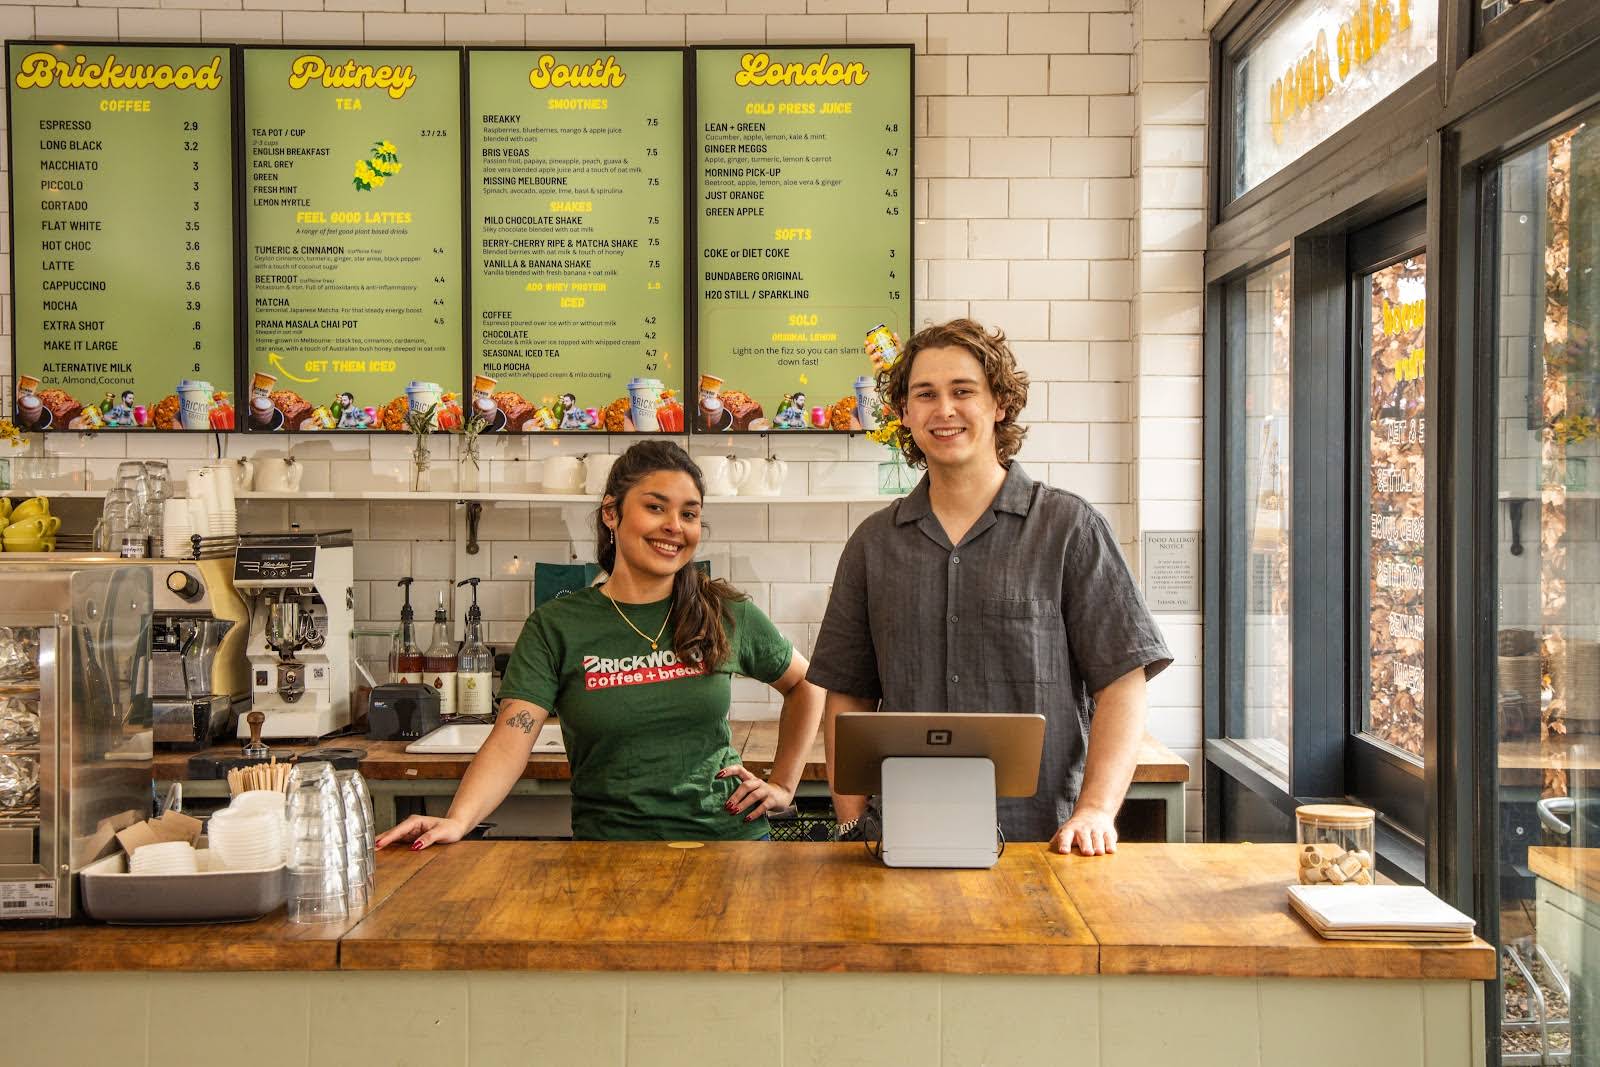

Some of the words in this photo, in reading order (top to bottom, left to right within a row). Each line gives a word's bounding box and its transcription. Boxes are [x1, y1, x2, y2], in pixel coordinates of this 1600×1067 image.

[16, 52, 223, 90] Brickwood
[528, 54, 626, 90] South
[735, 53, 870, 87] London
[287, 54, 417, 101] Putney
[100, 99, 150, 113] COFFEE
[336, 98, 361, 110] TEA
[745, 103, 774, 114] COLD
[779, 103, 815, 113] PRESS
[821, 103, 852, 113] JUICE
[483, 115, 520, 123] BREAKKY
[40, 120, 91, 130] ESPRESSO
[184, 121, 198, 131] 2.9
[705, 123, 727, 131] LEAN
[737, 123, 765, 131] GREEN
[886, 124, 898, 132] 4.8
[40, 140, 66, 150] LONG
[70, 141, 102, 150] BLACK
[184, 141, 198, 151] 3.2
[705, 145, 736, 153] GINGER
[739, 145, 767, 153] MEGGS
[503, 149, 529, 157] VEGAS
[646, 148, 657, 156] 7.5
[886, 148, 898, 156] 4.7
[41, 160, 98, 170] MACCHIATO
[253, 160, 272, 168] EARL
[705, 169, 743, 177] MORNING
[746, 168, 780, 176] PICK-UP
[886, 168, 898, 176] 4.7
[253, 173, 278, 181] GREEN
[484, 177, 516, 185] MISSING
[518, 177, 567, 185] MELBOURNE
[41, 180, 83, 190] PICCOLO
[648, 178, 659, 186] 7.5
[705, 191, 727, 199] JUST
[730, 191, 764, 199] ORANGE
[885, 189, 897, 197] 4.5
[41, 200, 88, 211] CORTADO
[706, 208, 734, 216] GREEN
[737, 208, 764, 216] APPLE
[295, 211, 325, 224] FEEL
[330, 212, 362, 223] GOOD
[364, 212, 411, 224] LATTES
[42, 221, 67, 230] FLAT
[70, 221, 101, 230] WHITE
[186, 222, 199, 231] 3.5
[775, 228, 812, 241] SOFTS
[41, 241, 62, 251] HOT
[65, 241, 91, 251] CHOC
[186, 242, 199, 251] 3.6
[649, 238, 659, 246] 7.5
[255, 246, 290, 254] TUMERIC
[293, 246, 298, 254] &
[301, 246, 344, 254] CINNAMON
[704, 249, 728, 258] COKE
[743, 249, 763, 257] DIET
[766, 248, 789, 257] COKE
[43, 261, 74, 270] LATTE
[186, 262, 200, 270] 3.6
[484, 260, 518, 268] VANILLA
[521, 260, 526, 268] &
[529, 260, 562, 268] BANANA
[565, 260, 591, 268] SHAKE
[649, 260, 660, 268] 7.5
[255, 275, 297, 283] BEETROOT
[705, 272, 759, 280] BUNDABERG
[762, 272, 803, 280] ORIGINAL
[43, 281, 106, 290] CAPPUCCINO
[186, 282, 200, 290] 3.6
[43, 301, 77, 311] MOCHA
[186, 301, 200, 310] 3.9
[256, 298, 289, 306] MATCHA
[44, 321, 76, 330] EXTRA
[79, 321, 104, 330] SHOT
[256, 320, 283, 328] PRANA
[286, 320, 319, 328] MASALA
[321, 320, 339, 328] CHAI
[44, 341, 71, 350] MAKE
[74, 341, 82, 350] IT
[86, 341, 118, 350] LARGE
[483, 349, 523, 357] SEASONAL
[733, 347, 752, 356] Light
[807, 348, 822, 356] you
[43, 363, 107, 372] ALTERNATIVE
[110, 363, 132, 372] MILK
[504, 363, 530, 371] MOCHA
[42, 376, 59, 384] Oat,
[62, 376, 134, 384] Almond,Coconut
[582, 646, 704, 674] BRICKWOD
[587, 672, 643, 688] coffee
[646, 671, 657, 681] +
